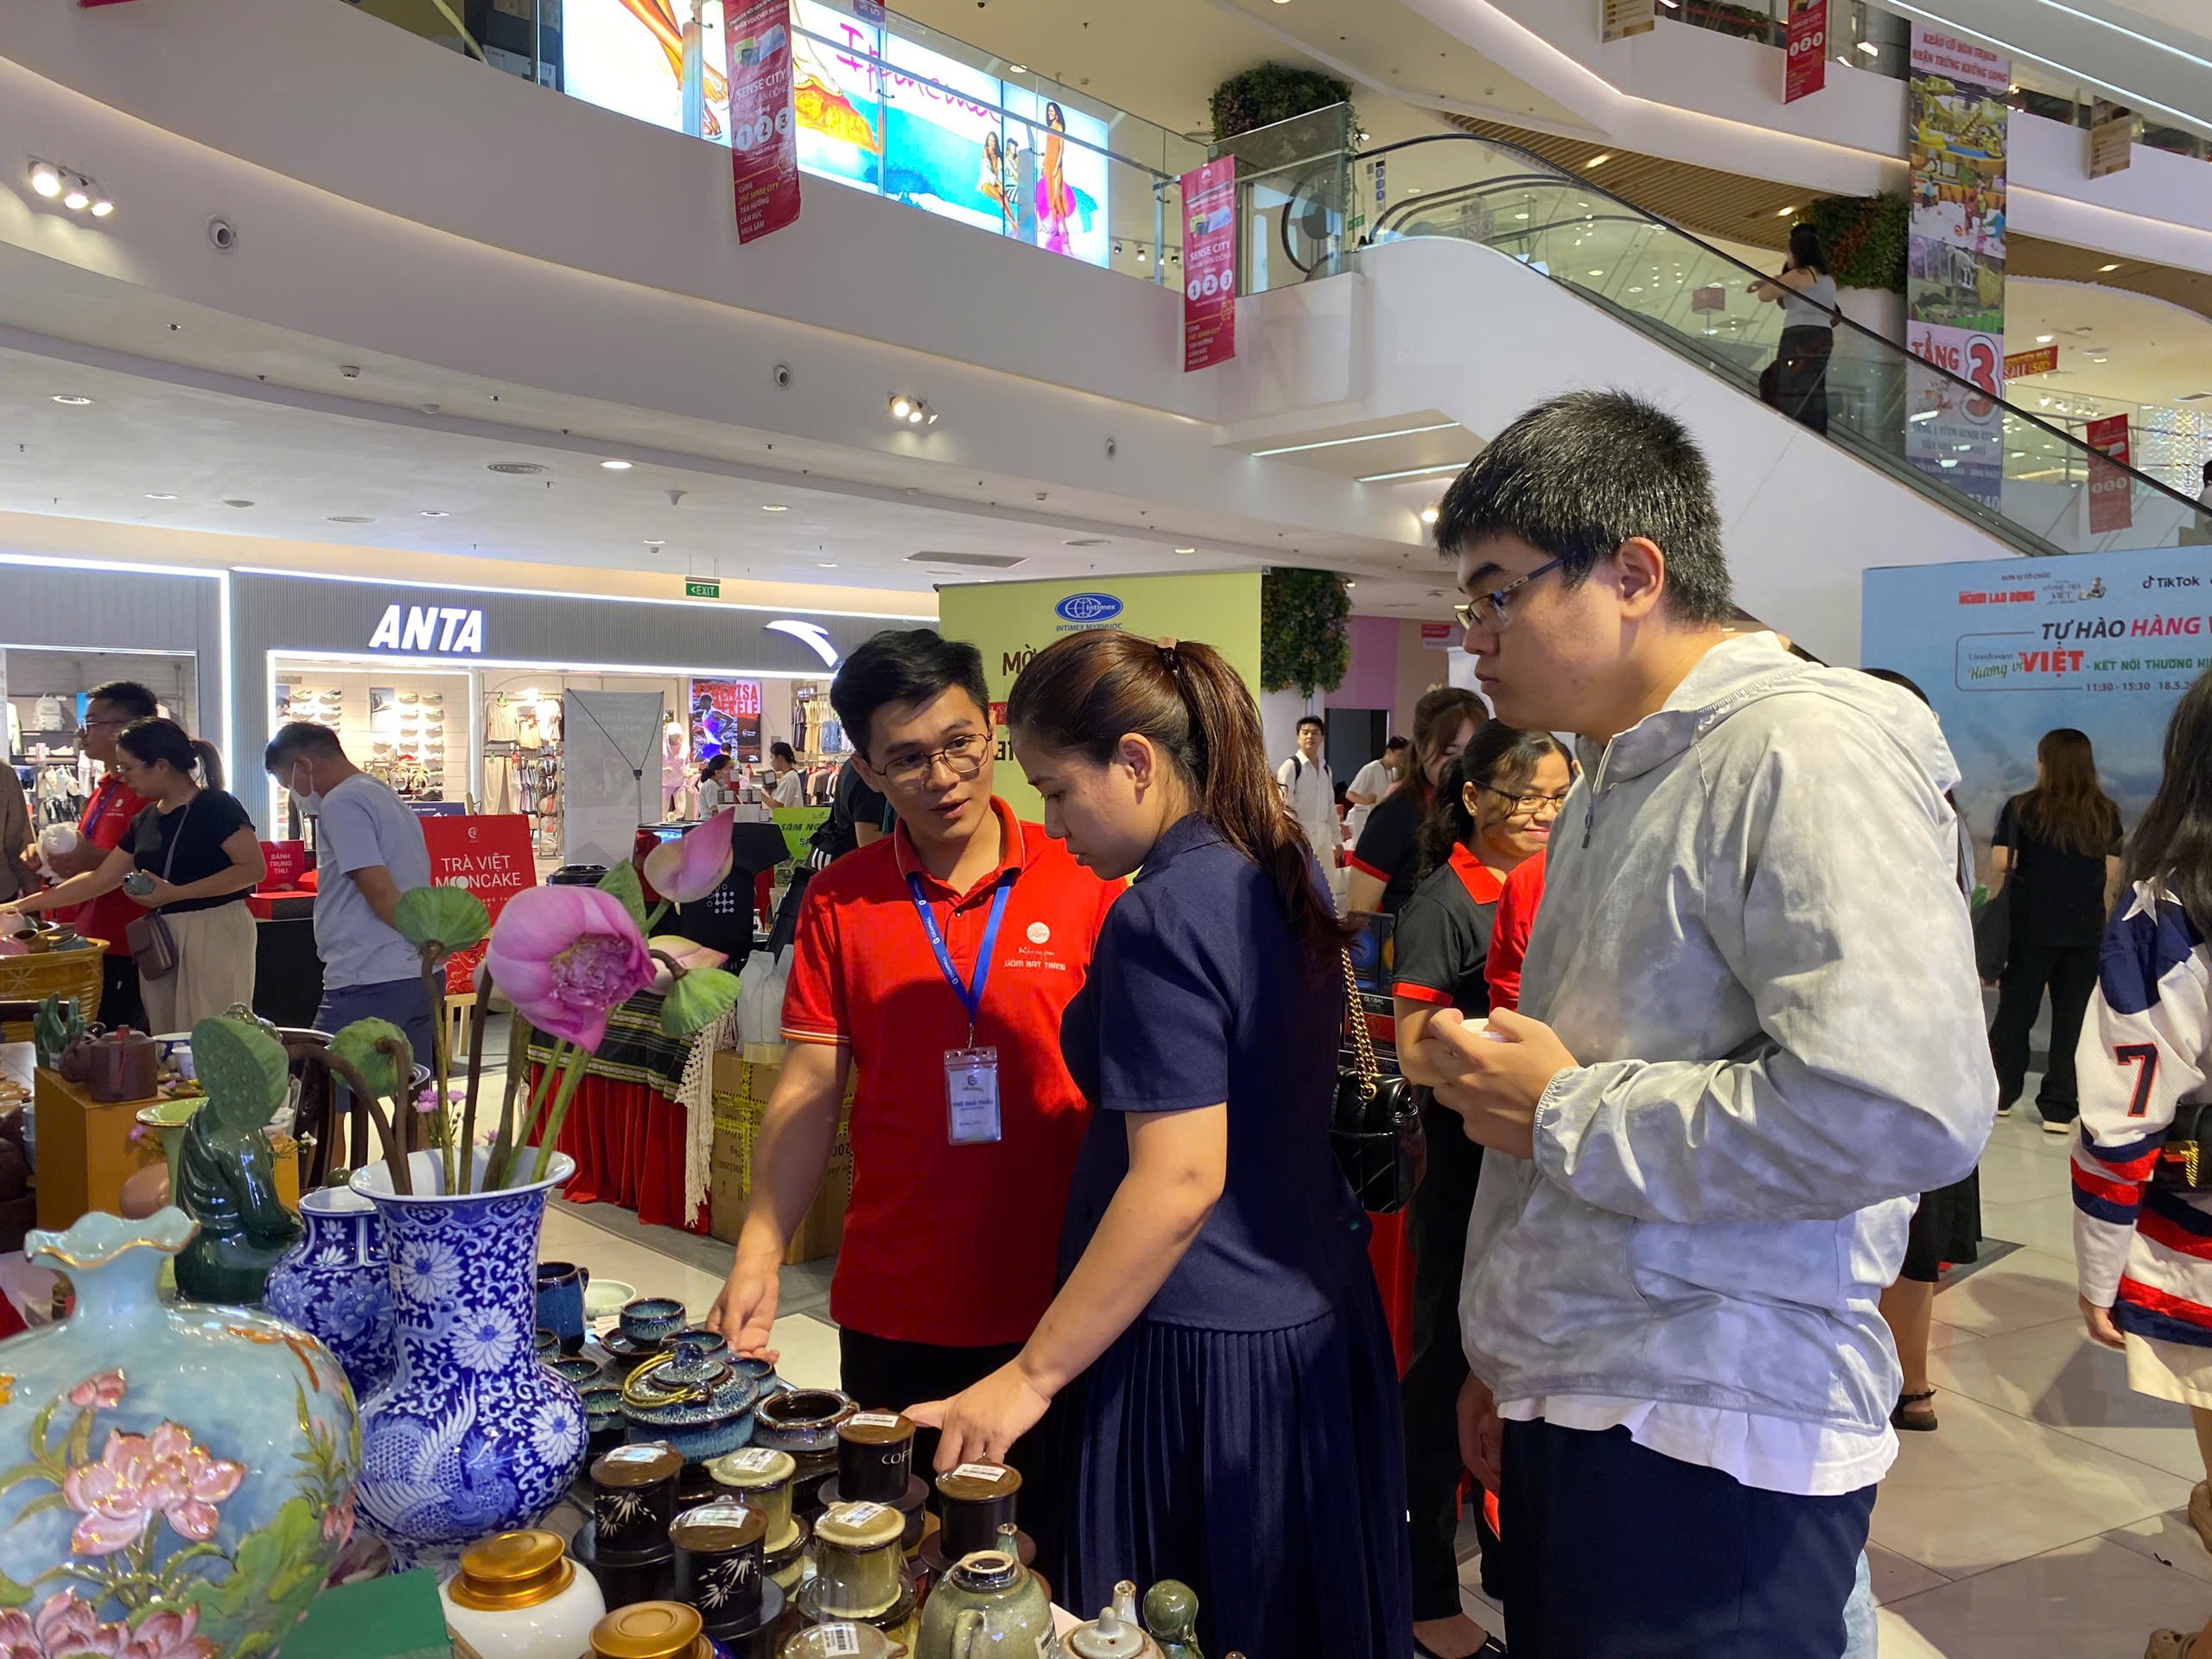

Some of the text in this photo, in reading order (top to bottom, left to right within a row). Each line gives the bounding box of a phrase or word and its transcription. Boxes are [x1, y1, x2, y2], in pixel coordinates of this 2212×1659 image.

[736, 69, 786, 100] SENSE CITY
[1212, 239, 1231, 253] CITY
[1962, 340, 1999, 421] 3
[2004, 364, 2027, 378] SALE
[696, 585, 715, 596] EXIT
[2156, 575, 2201, 588] TikTok
[1989, 592, 2006, 603] LAO
[368, 604, 482, 653] ANTA
[2042, 619, 2075, 645] TỰ
[2075, 616, 2126, 639] HÀO
[2130, 614, 2202, 638] HÀNG
[1002, 644, 1038, 676] MỜ
[2018, 645, 2085, 677] VIỆT
[2086, 682, 2113, 691] 11:30
[2122, 682, 2150, 691] 15:30
[441, 852, 512, 873] TRÀ VIỆT
[435, 872, 522, 890] MOONCAKE
[926, 916, 938, 938] GIGAMALL
[942, 956, 955, 979] GIGAMALL
[1363, 995, 1384, 1004] GLOBAL
[2113, 1042, 2158, 1117] 7
[881, 1449, 912, 1465] COF
